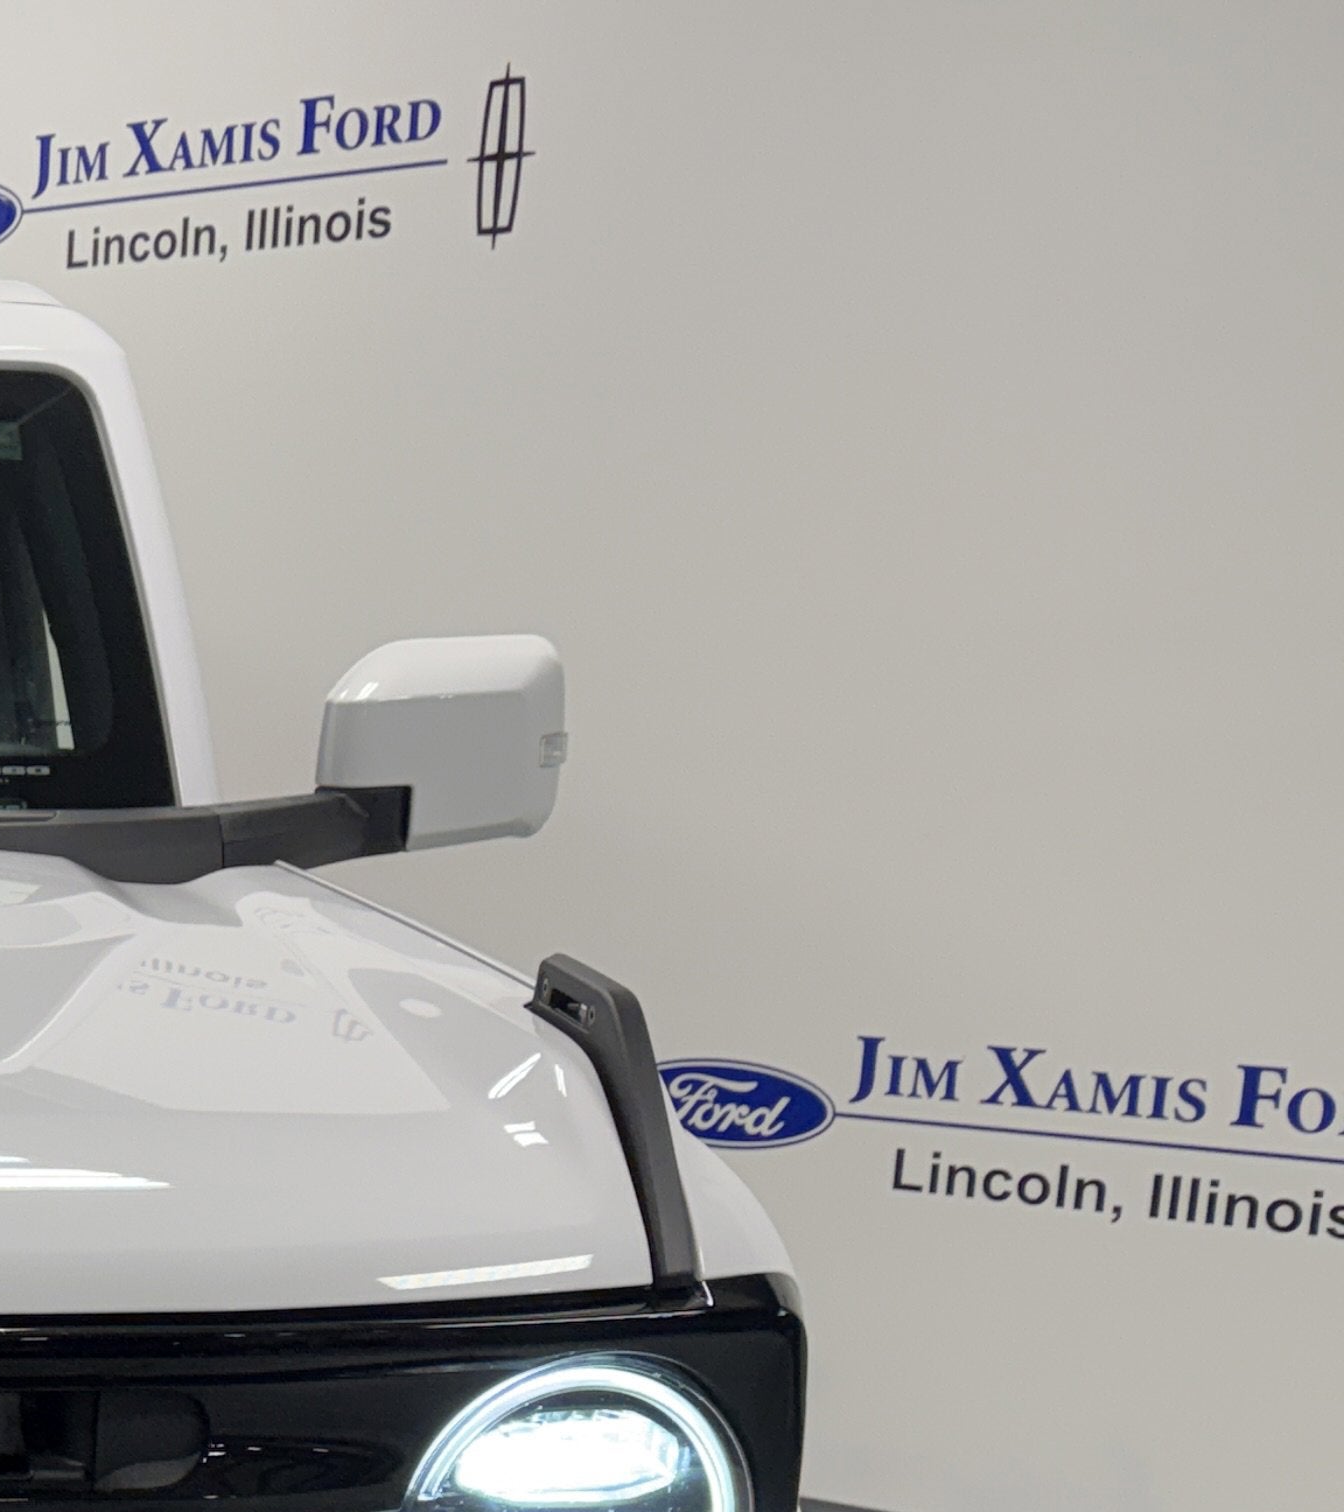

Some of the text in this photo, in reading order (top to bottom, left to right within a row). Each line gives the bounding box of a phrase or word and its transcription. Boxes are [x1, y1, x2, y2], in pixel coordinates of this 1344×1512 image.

[31, 94, 443, 200] JIM XAMIS FORD
[65, 196, 393, 270] Lincoln, Illinois
[668, 1072, 791, 1136] Ford
[849, 1036, 1344, 1136] JIM XAMIS FO
[891, 1148, 1122, 1224] Lincoln,
